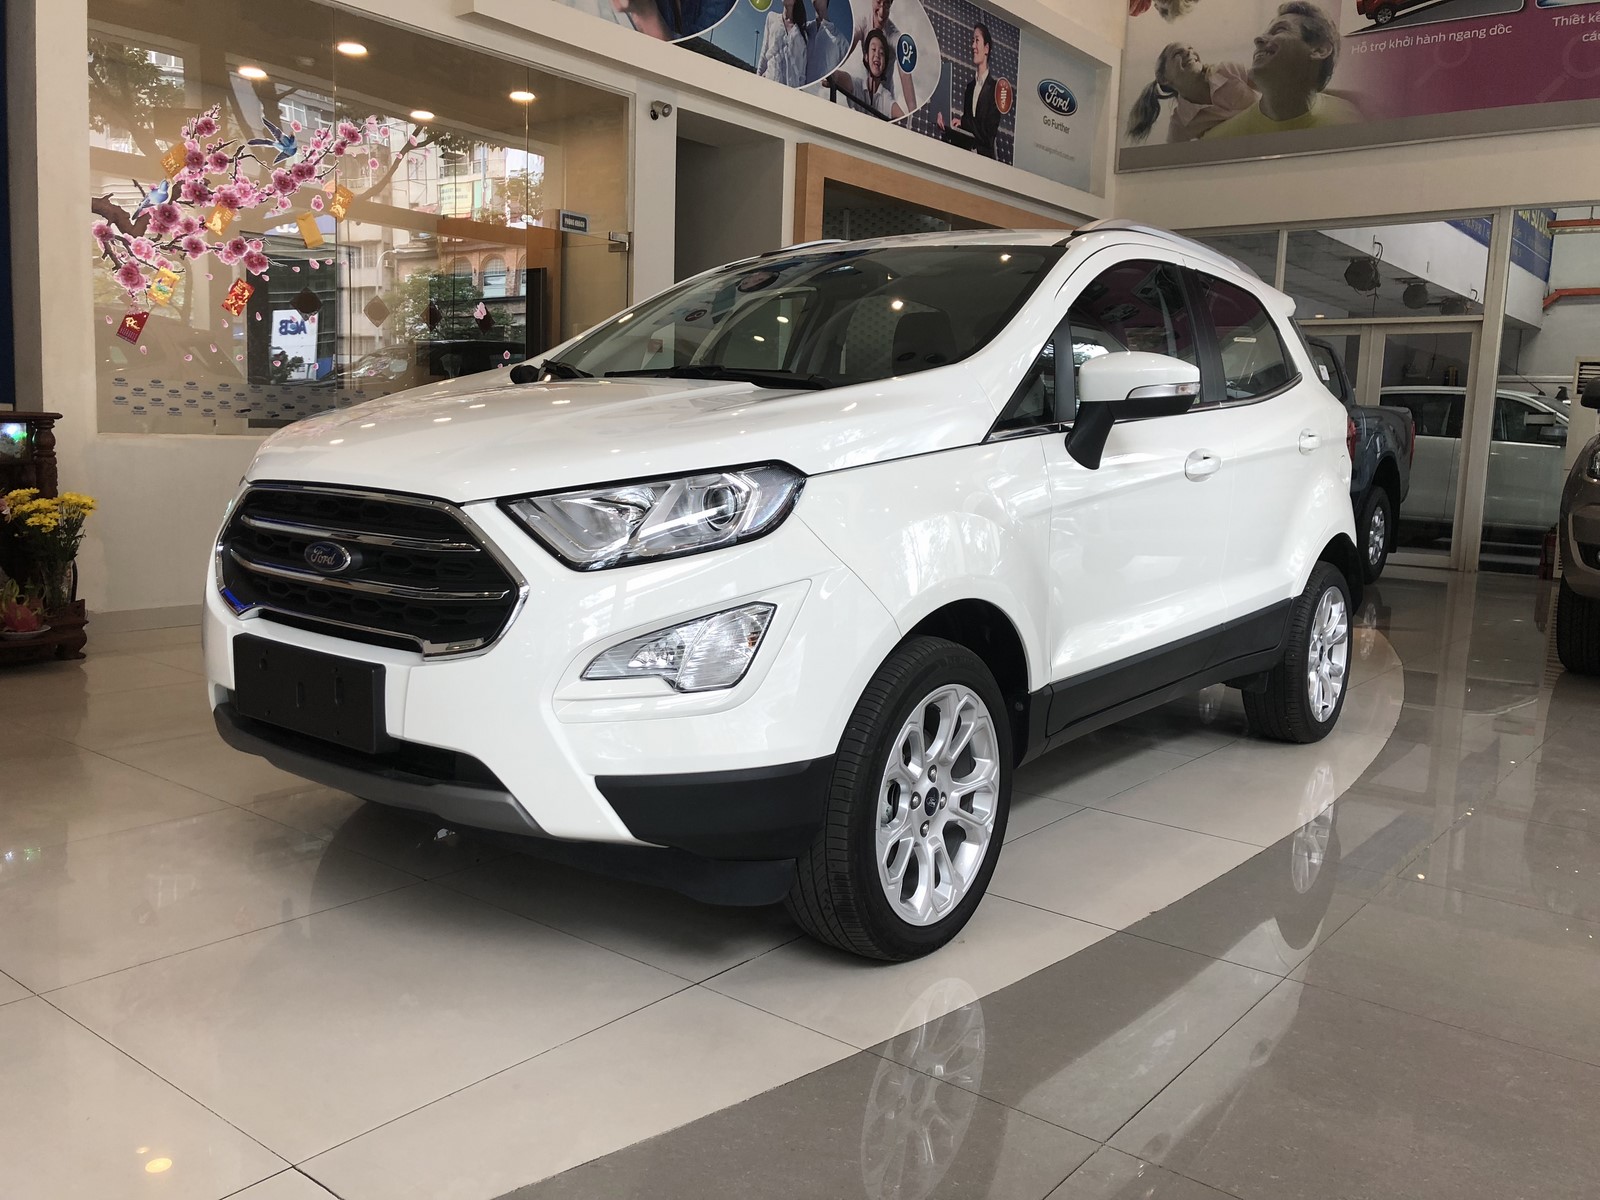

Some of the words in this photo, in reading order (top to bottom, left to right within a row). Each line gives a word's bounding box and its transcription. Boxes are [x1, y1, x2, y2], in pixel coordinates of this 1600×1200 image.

[1350, 41, 1368, 55] Hỗ
[1370, 41, 1387, 53] trợ
[1389, 36, 1414, 49] khởi
[1416, 32, 1446, 46] hành
[1448, 28, 1487, 42] ngang
[1045, 83, 1070, 111] Ford
[1043, 115, 1052, 127] Go
[1051, 118, 1070, 134] Further
[311, 545, 336, 565] Ford
